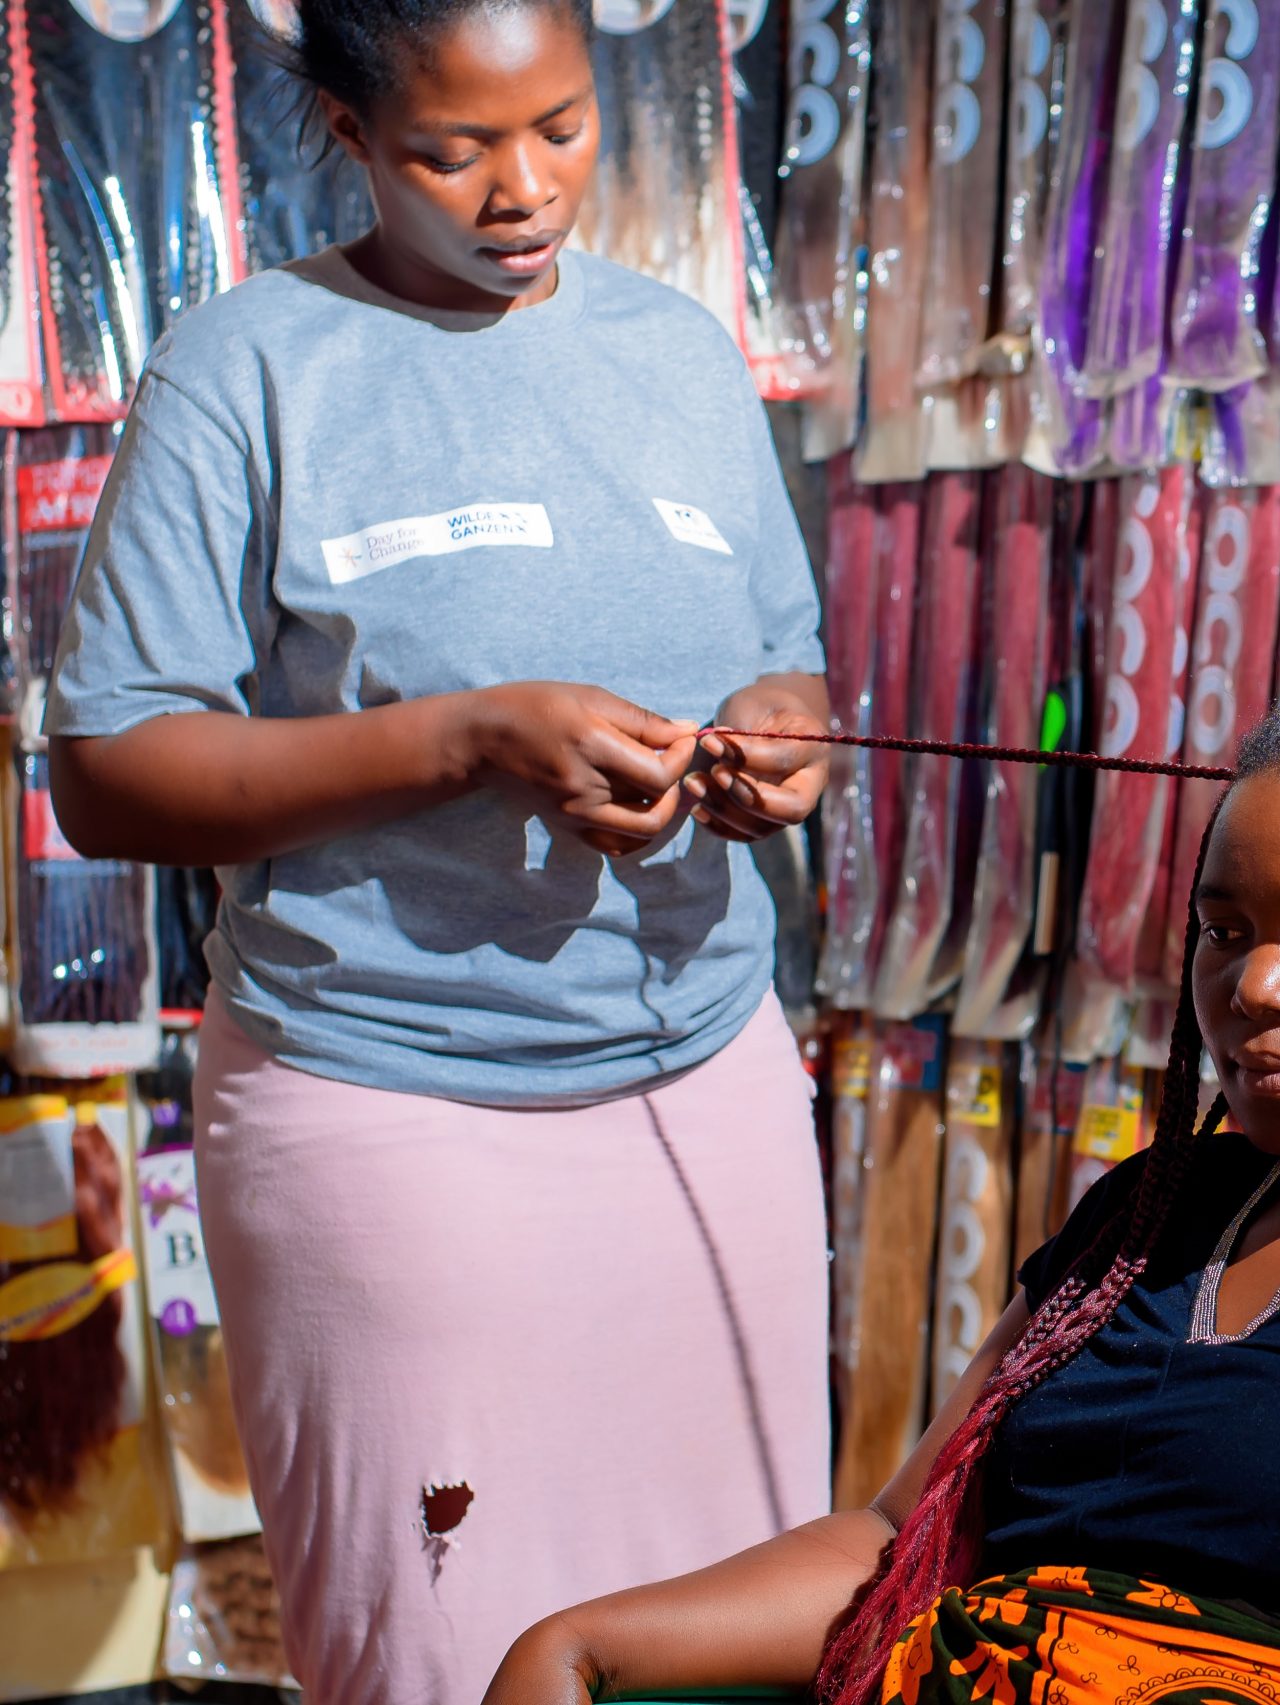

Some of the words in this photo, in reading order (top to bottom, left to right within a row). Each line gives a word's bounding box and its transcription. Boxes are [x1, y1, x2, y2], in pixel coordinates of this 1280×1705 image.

[447, 511, 494, 528] WILDE
[366, 530, 395, 549] Day
[451, 524, 514, 540] GANZEN
